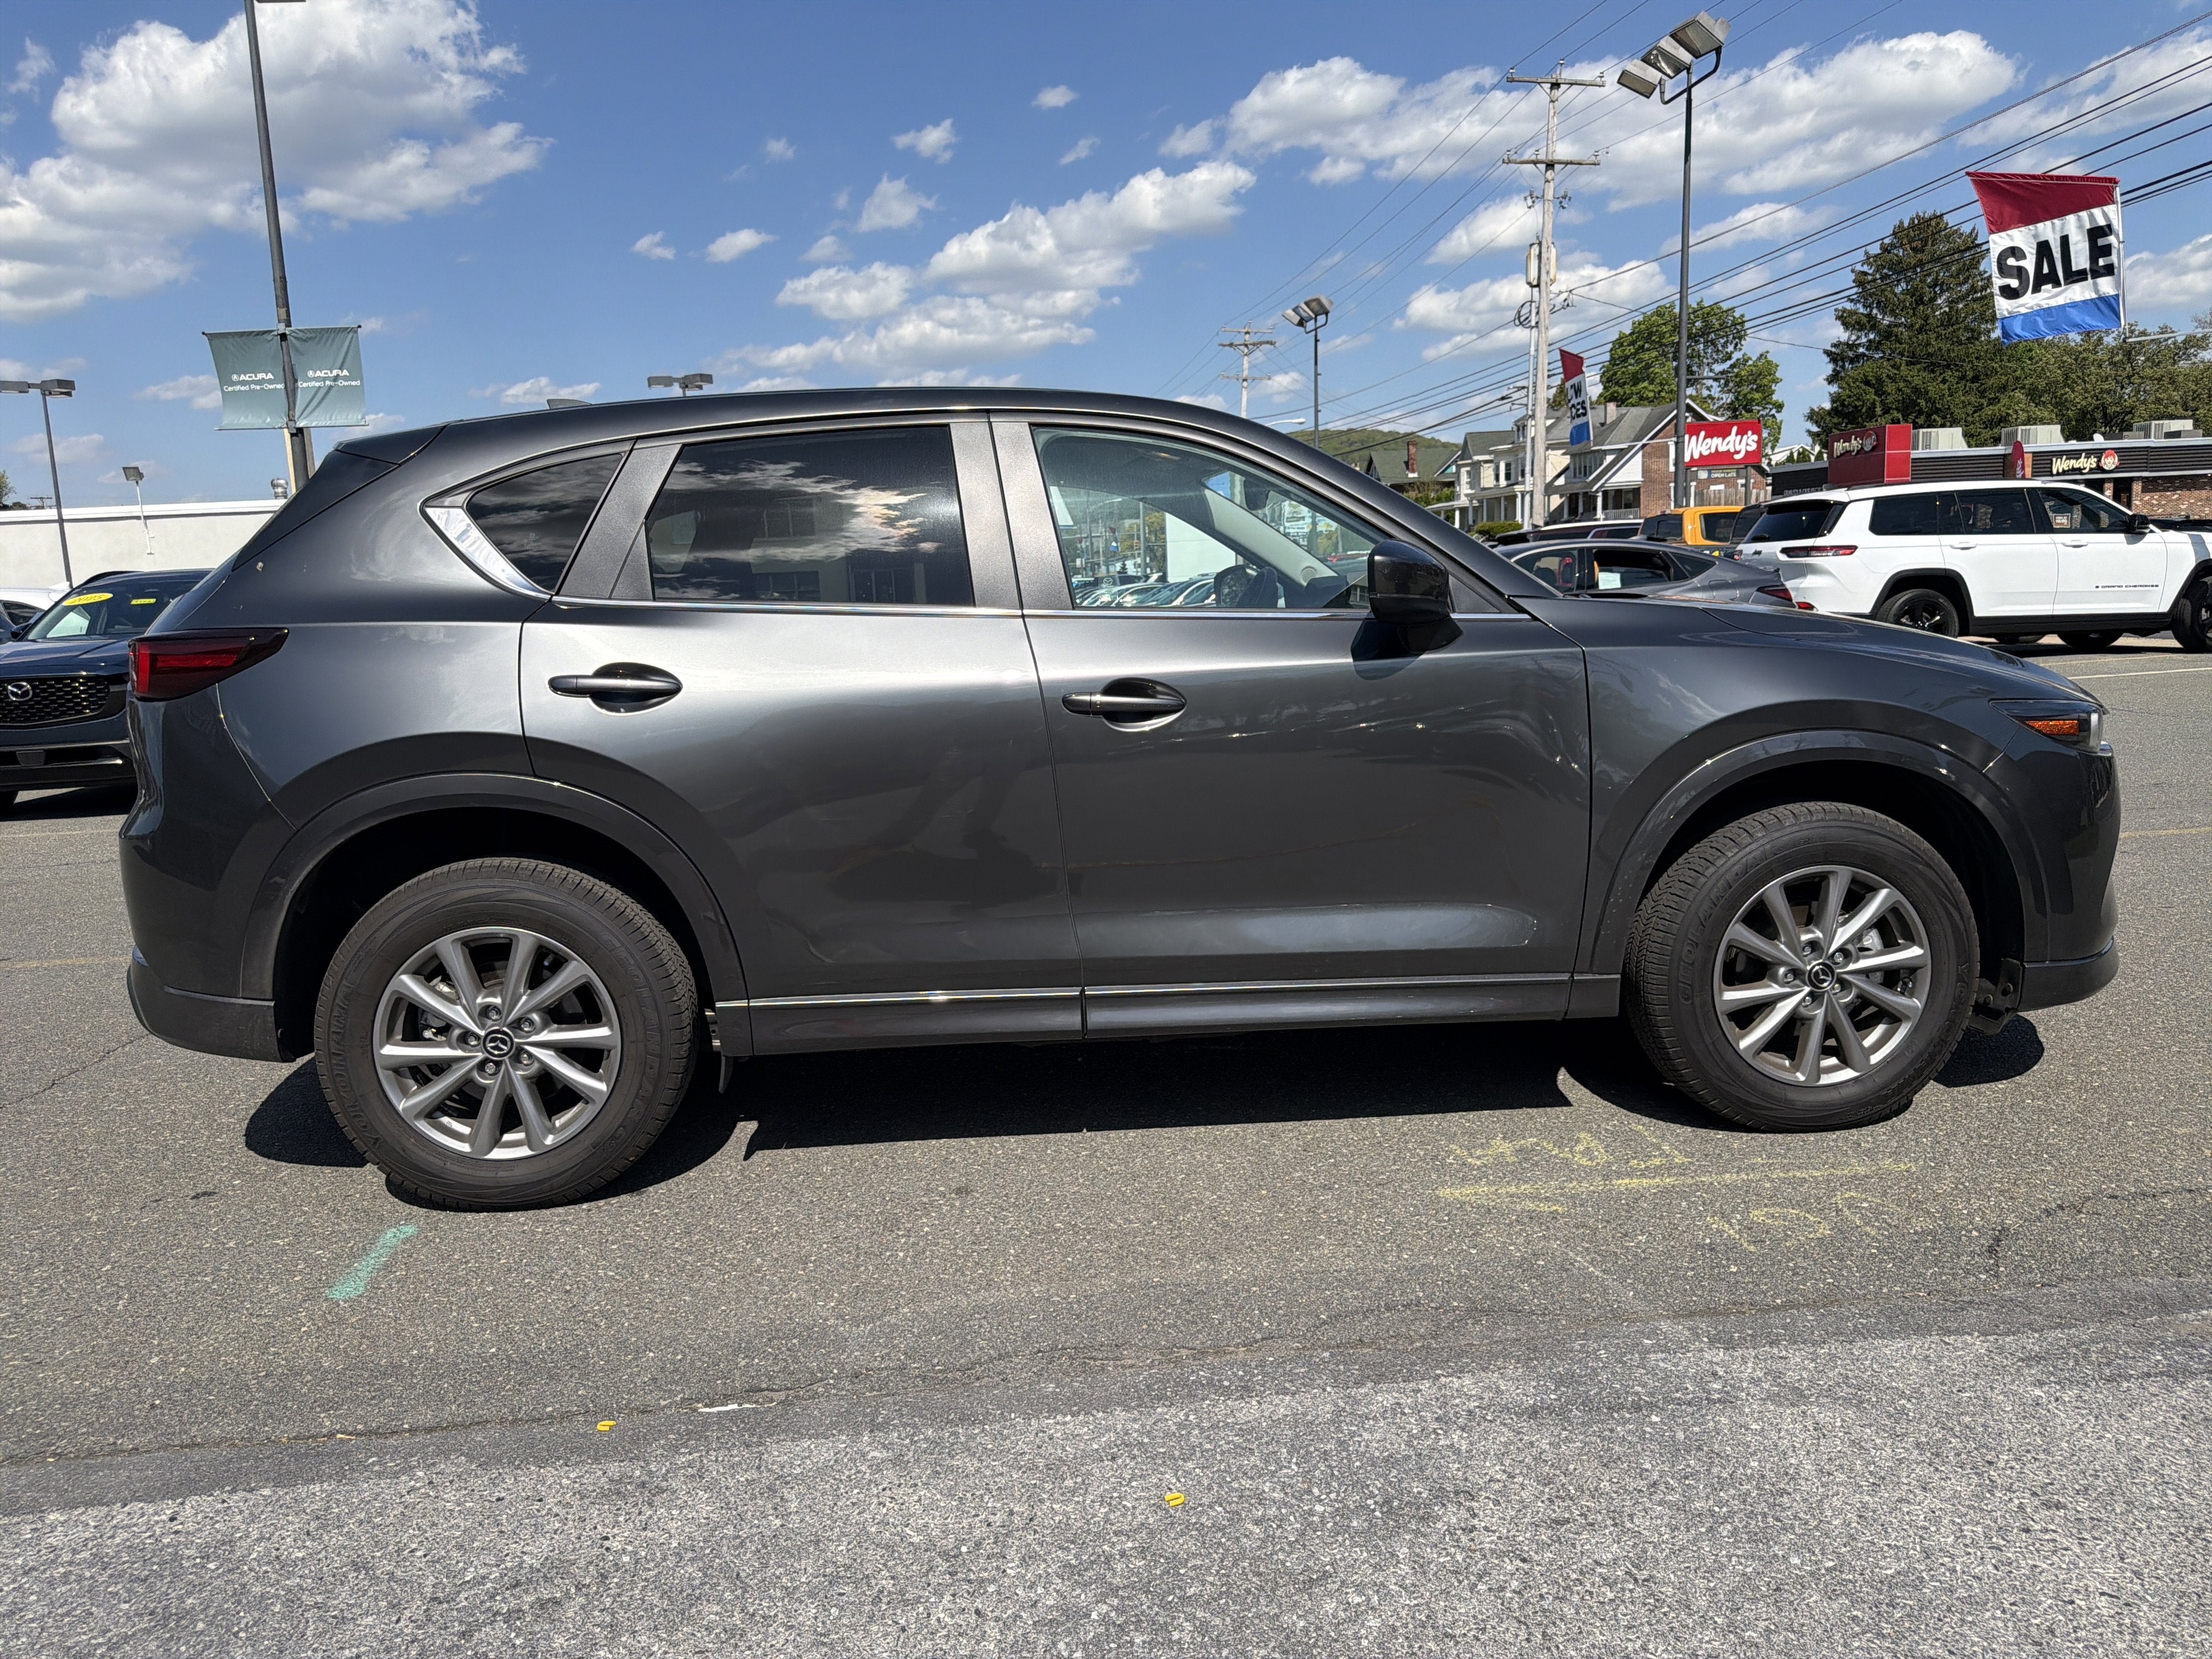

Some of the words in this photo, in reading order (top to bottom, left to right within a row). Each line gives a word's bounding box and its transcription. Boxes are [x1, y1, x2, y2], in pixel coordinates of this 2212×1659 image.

[1996, 223, 2115, 301] SALE
[239, 373, 274, 381] ACURA
[314, 369, 349, 377] ACURA
[1684, 425, 1759, 462] Wendy's
[1833, 435, 1863, 459] Wendy's
[2052, 452, 2097, 475] Wendy's
